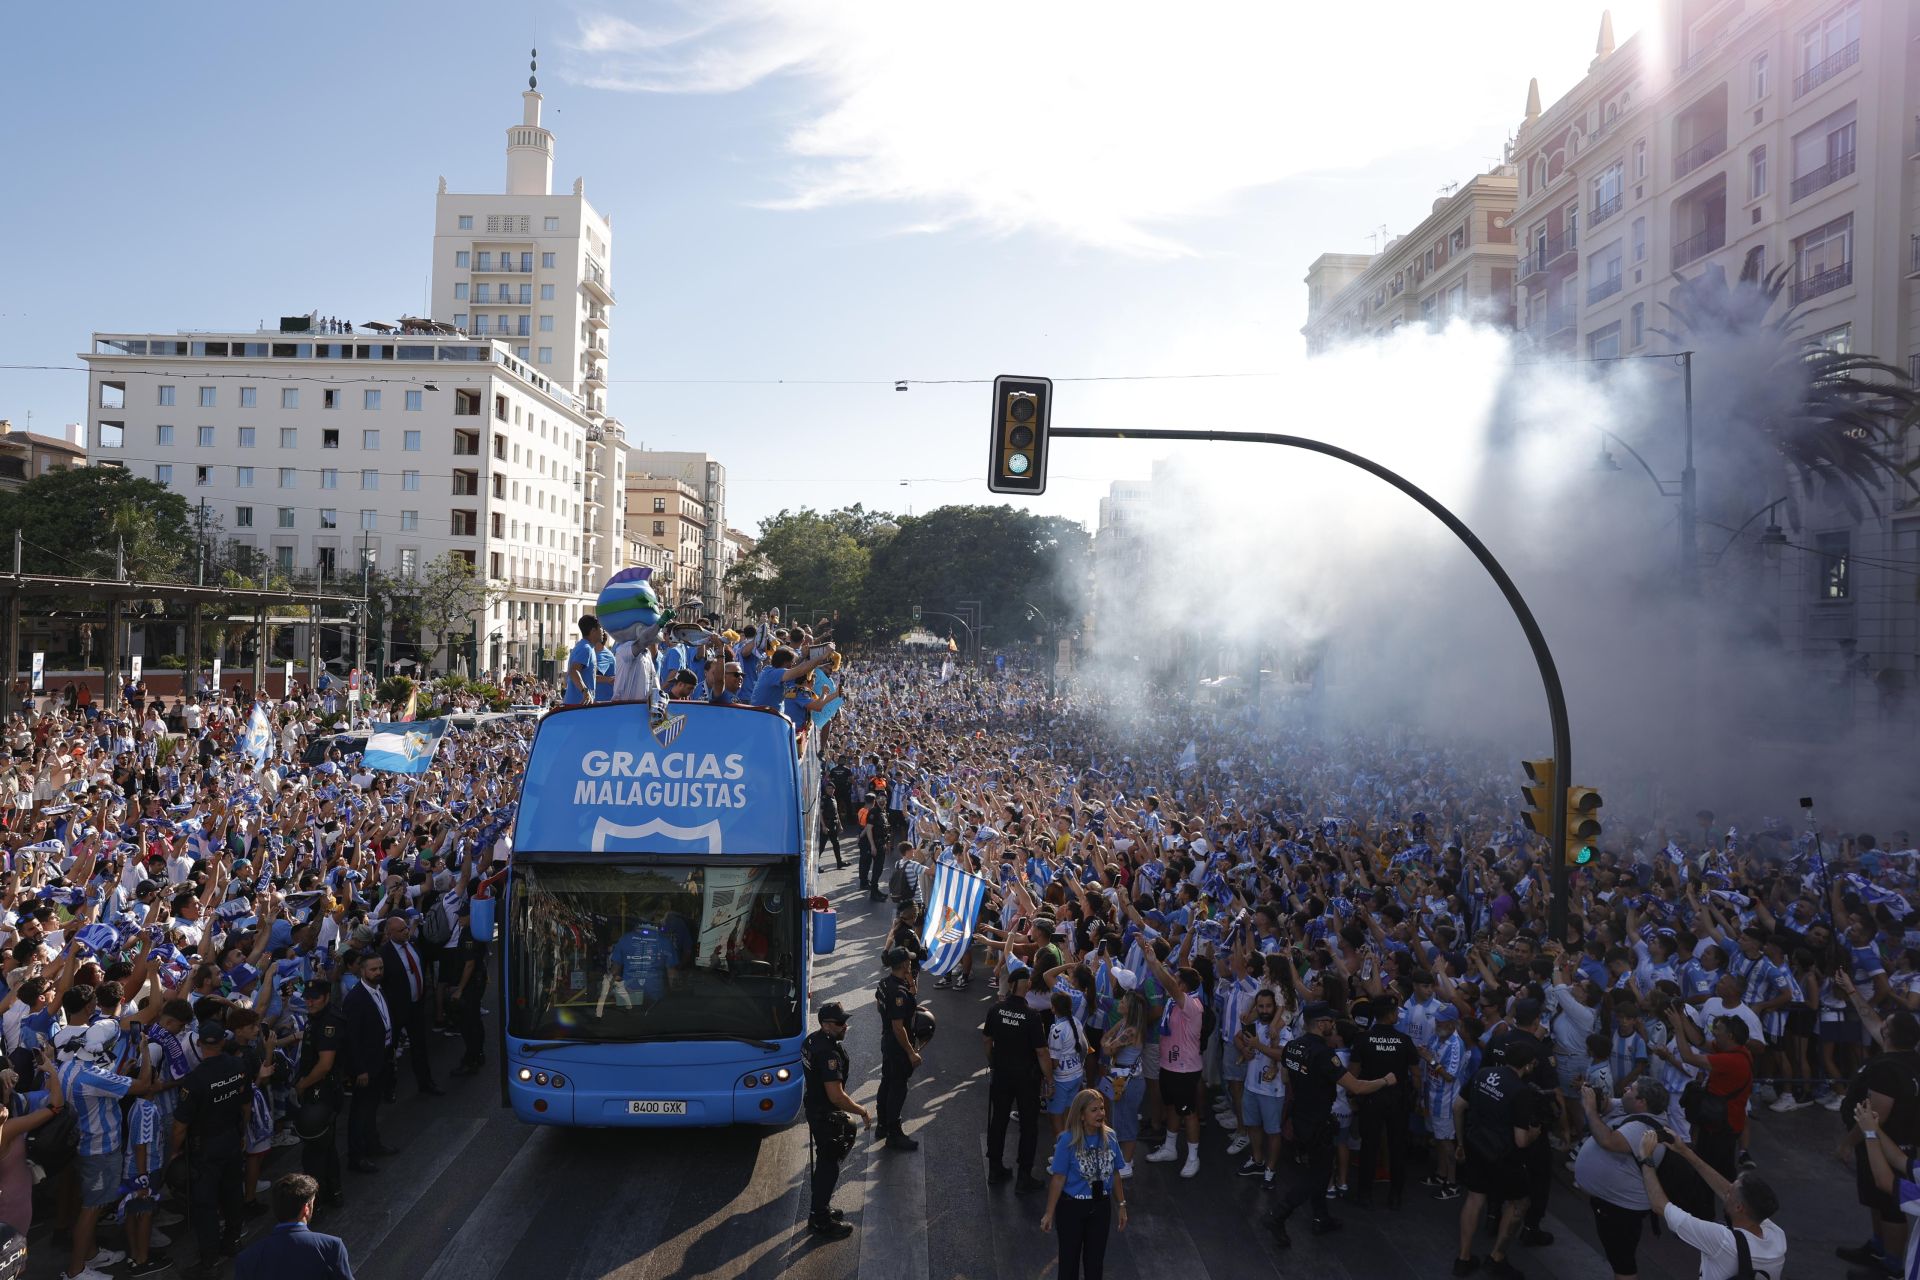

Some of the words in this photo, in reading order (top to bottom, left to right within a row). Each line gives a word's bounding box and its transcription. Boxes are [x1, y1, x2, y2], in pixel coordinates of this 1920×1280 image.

[581, 750, 744, 780] GRACIAS
[573, 780, 746, 809] MALAGUISTAS
[790, 1001, 798, 1013] 7
[633, 1102, 659, 1113] 8400
[663, 1102, 682, 1113] GXK
